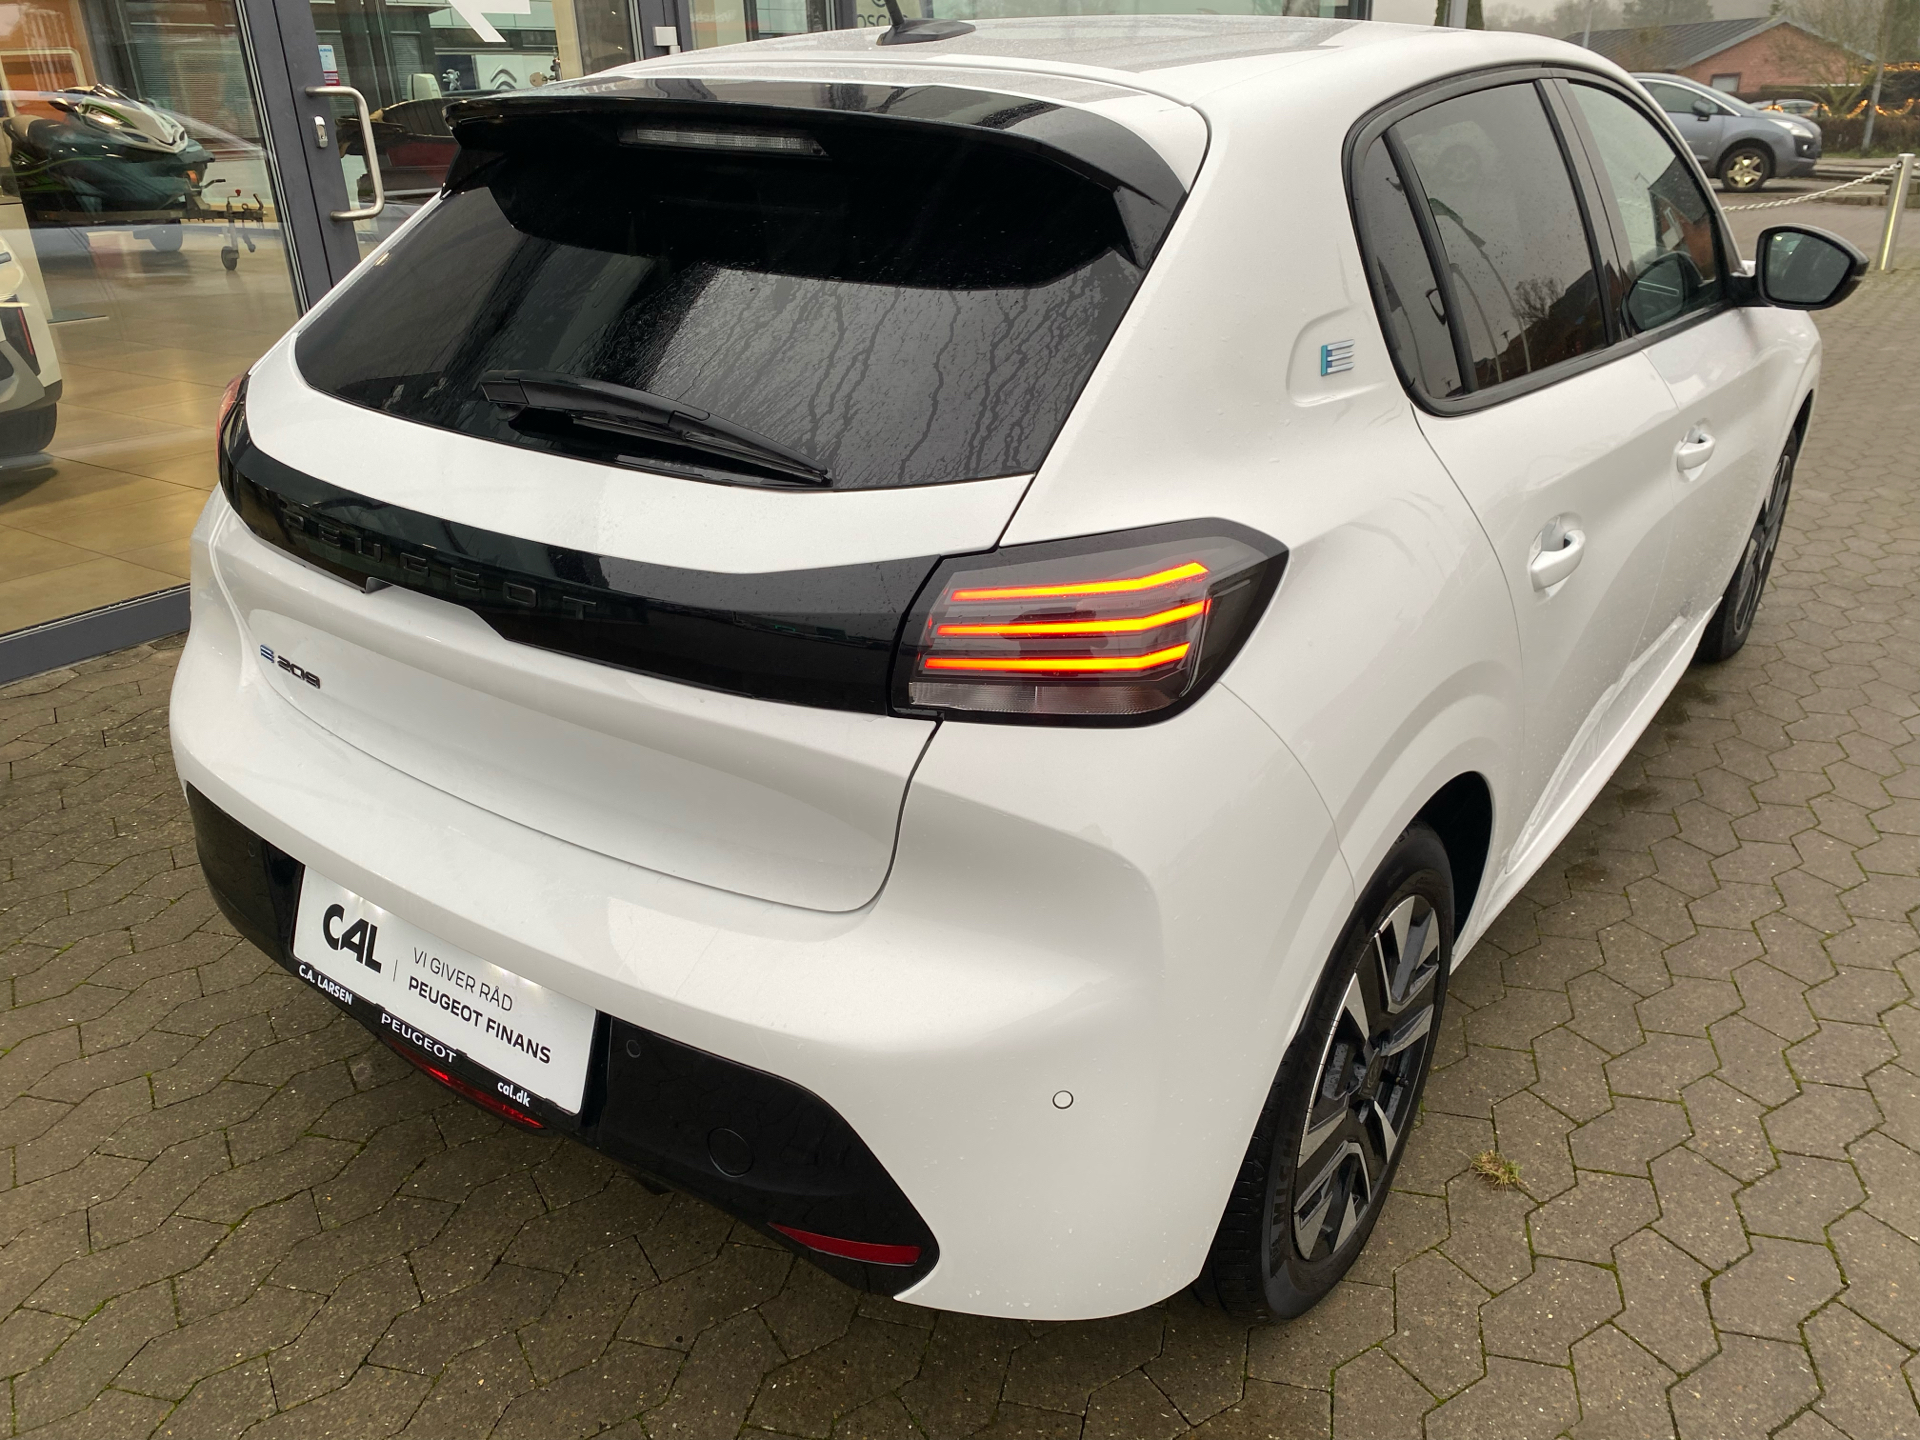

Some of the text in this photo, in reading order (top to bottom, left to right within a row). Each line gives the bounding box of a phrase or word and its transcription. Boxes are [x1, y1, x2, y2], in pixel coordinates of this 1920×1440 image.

[285, 511, 598, 621] PEUGEOT
[322, 904, 382, 974] CAL
[298, 965, 352, 1005] C.A. LARSEN
[413, 947, 513, 1012] VI GIVER RÅD
[381, 1013, 457, 1063] PEUGEOT
[408, 976, 551, 1064] PEUGEOT FINANS
[497, 1081, 531, 1107] cal.dk
